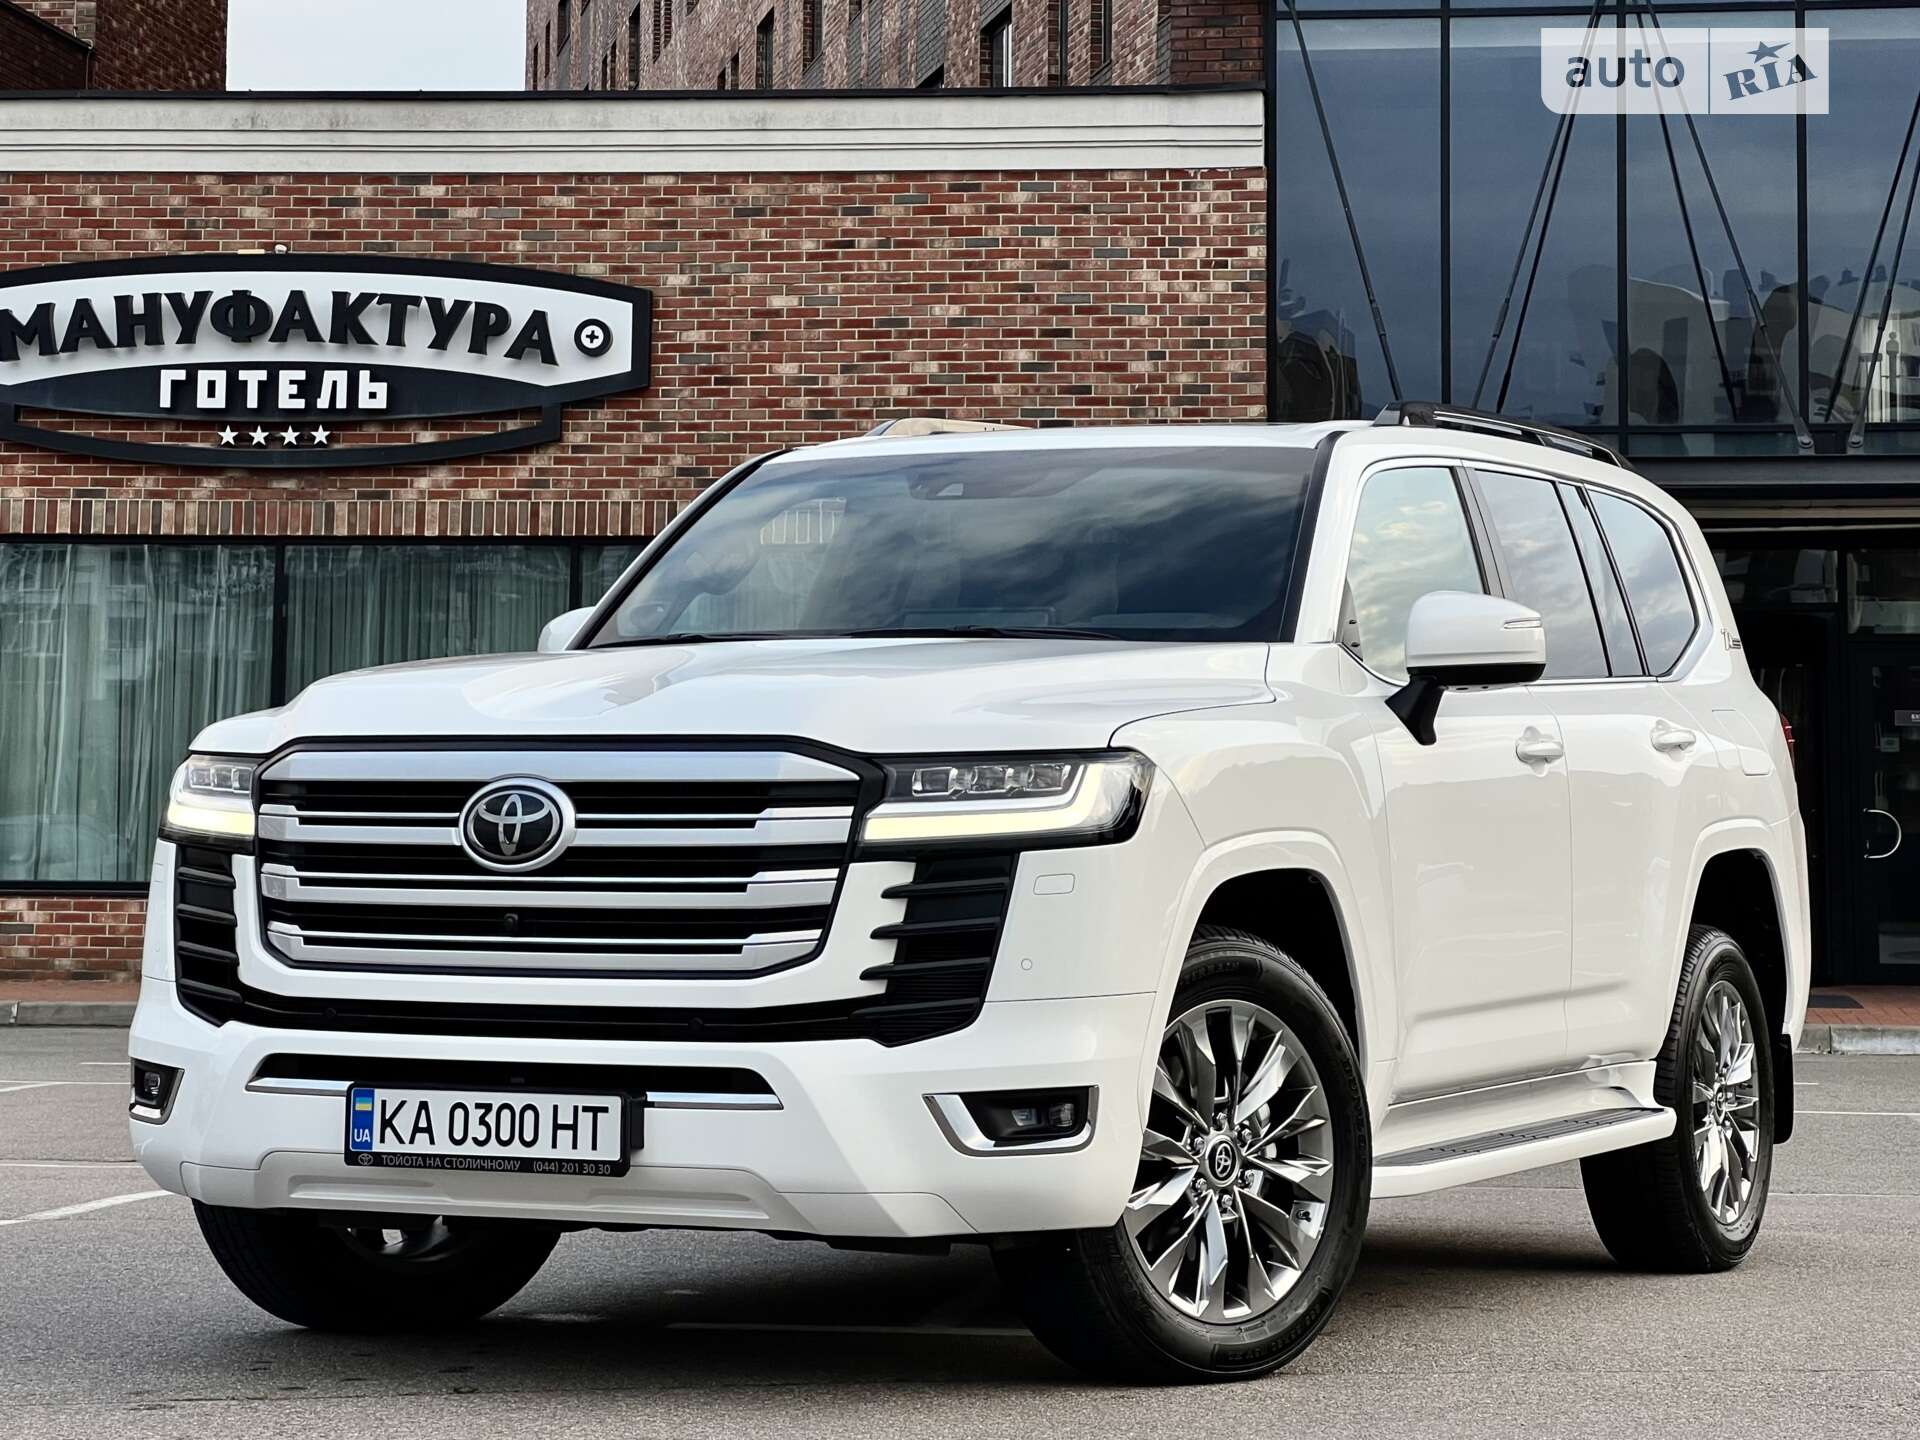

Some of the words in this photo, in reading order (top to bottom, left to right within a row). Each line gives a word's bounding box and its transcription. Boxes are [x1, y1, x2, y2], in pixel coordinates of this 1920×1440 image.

[0, 290, 559, 366] МАНУФАКТУРА
[159, 369, 389, 410] ГОТЕЛЬ
[354, 1128, 371, 1143] UA
[449, 1102, 540, 1148] 0300
[381, 1154, 424, 1167] ТОЙОТА
[426, 1157, 441, 1168] НА
[443, 1157, 520, 1171] СТОЛИЧНОМУ
[533, 1161, 559, 1173] (044)
[561, 1162, 579, 1173] 201
[582, 1163, 595, 1174] 30
[598, 1164, 611, 1175] 30
